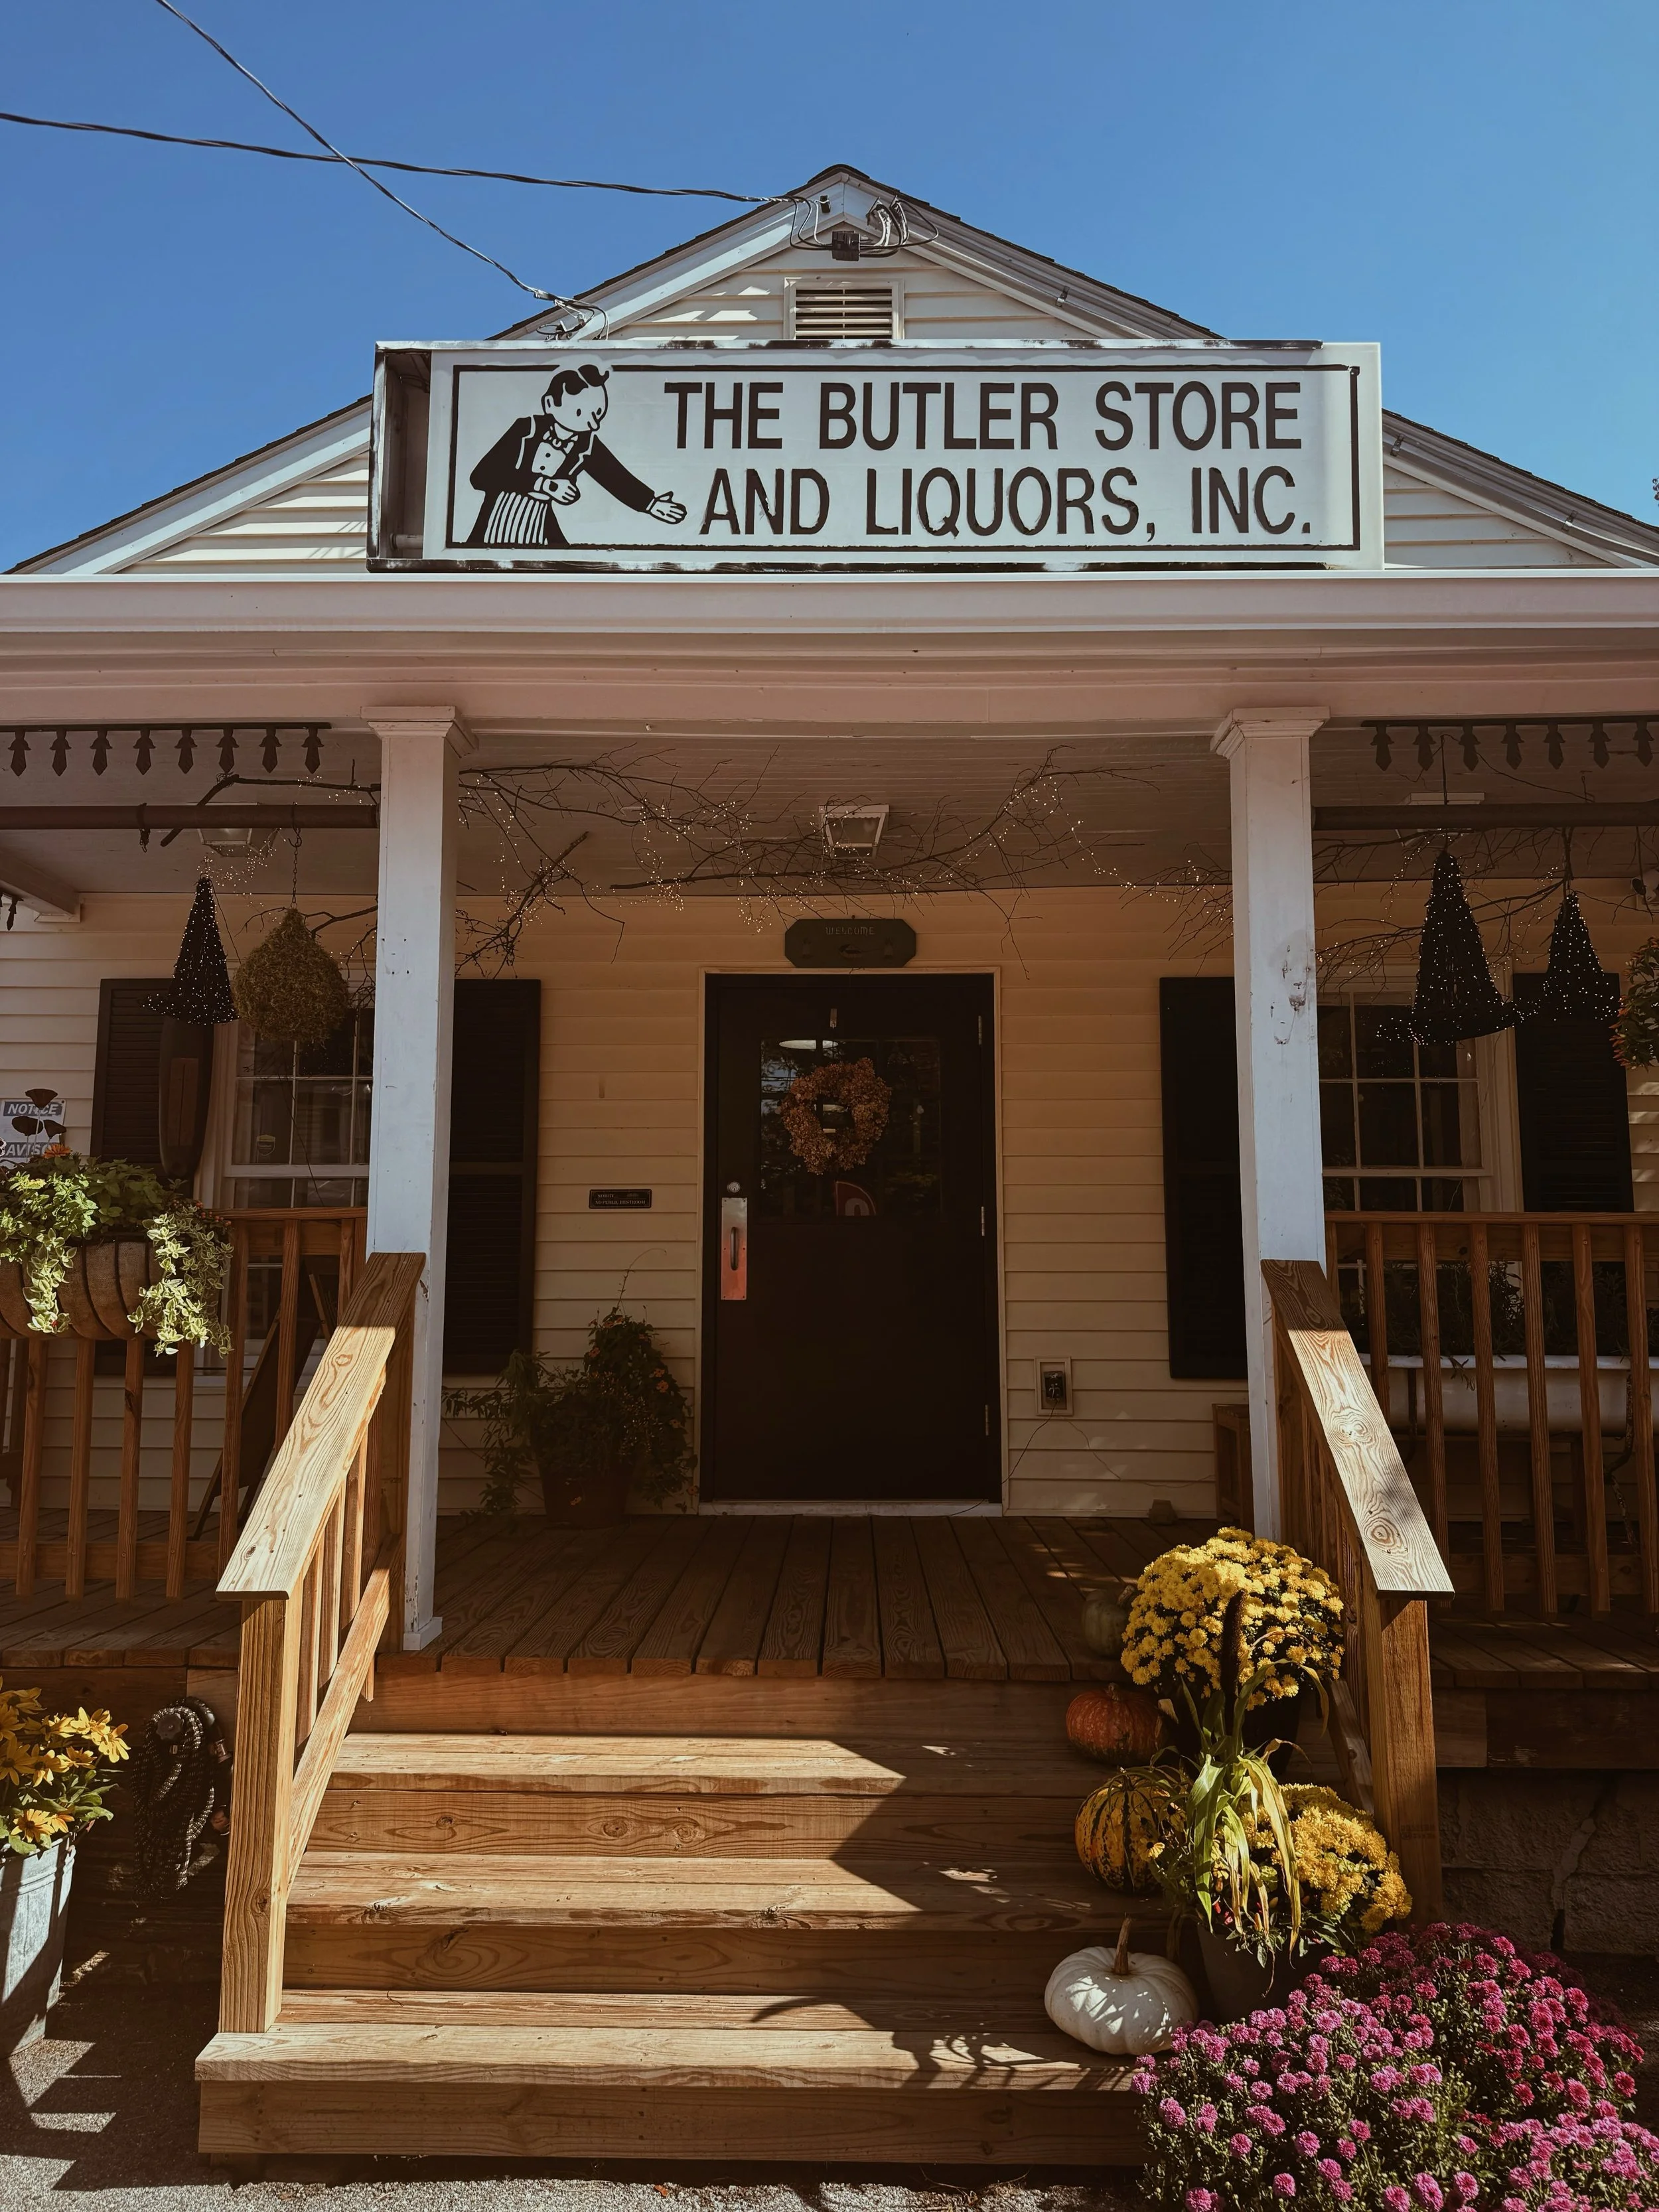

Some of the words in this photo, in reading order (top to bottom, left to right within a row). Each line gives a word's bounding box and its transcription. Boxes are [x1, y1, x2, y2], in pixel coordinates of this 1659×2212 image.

[664, 382, 783, 449] THE
[820, 382, 1058, 451] BUTLER
[1095, 381, 1301, 451] STORE
[699, 468, 830, 535] AND
[866, 467, 1155, 542] LIQUORS,
[1192, 466, 1310, 535] INC.
[825, 926, 874, 936] WELCOME
